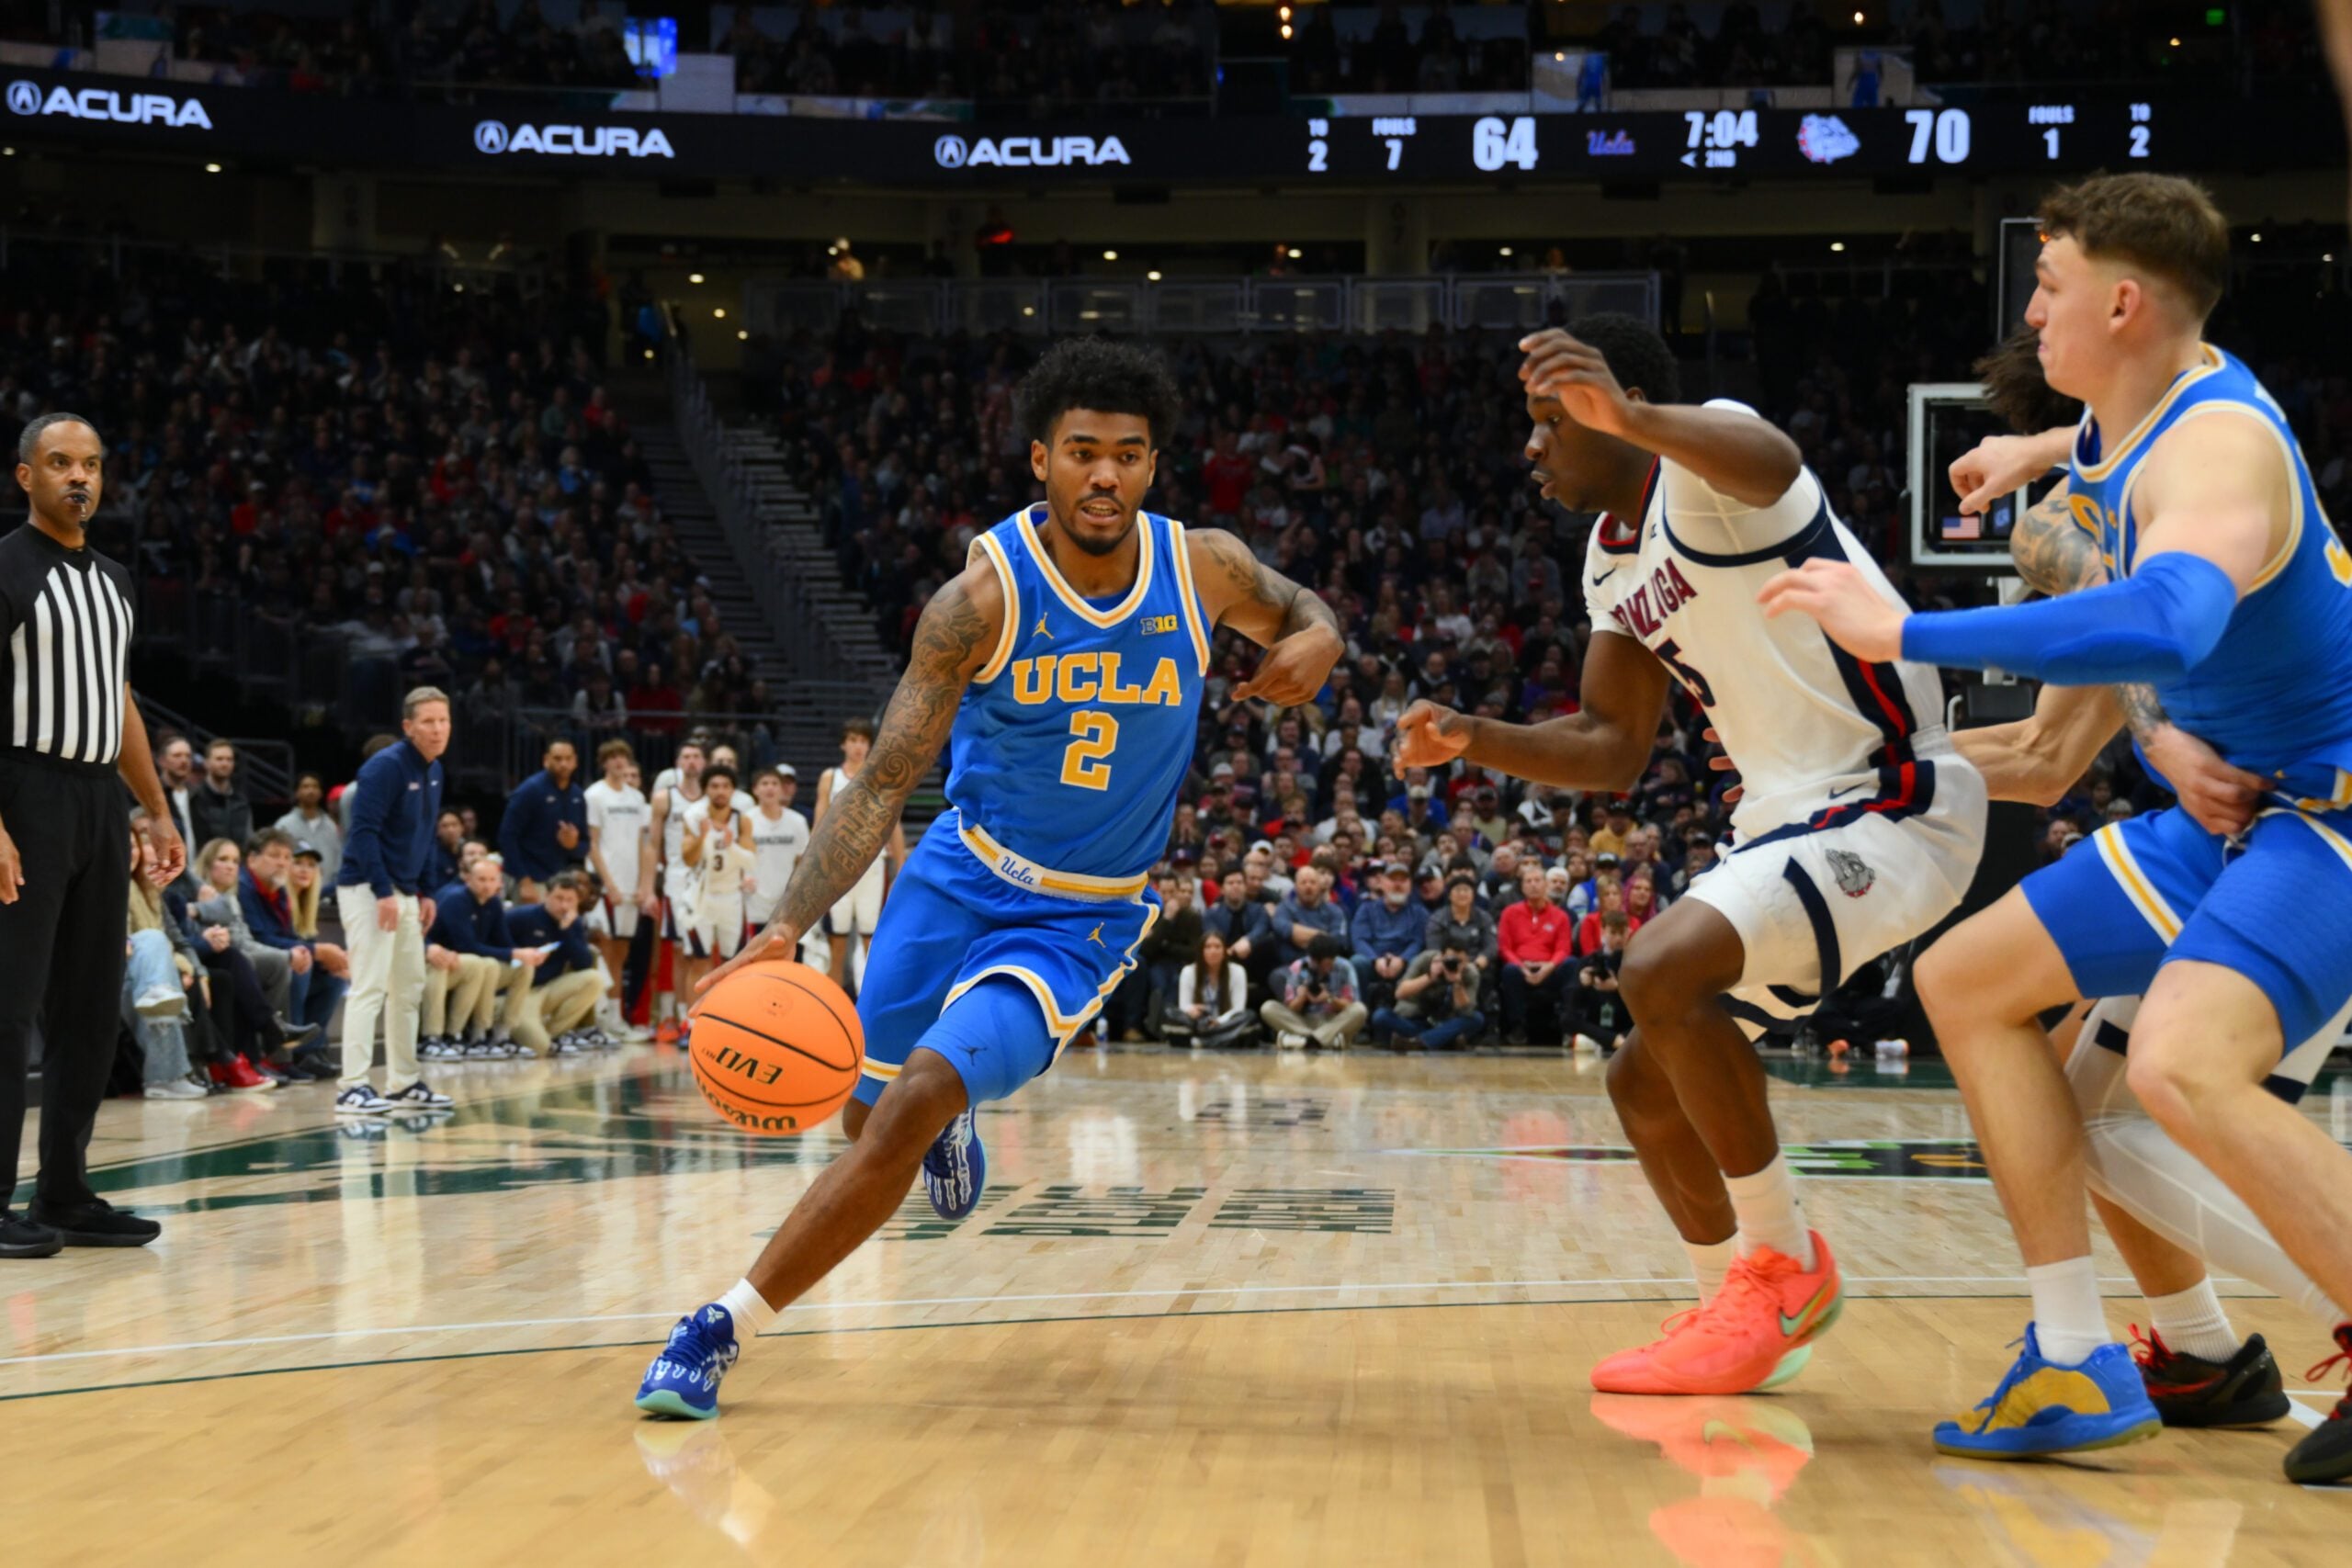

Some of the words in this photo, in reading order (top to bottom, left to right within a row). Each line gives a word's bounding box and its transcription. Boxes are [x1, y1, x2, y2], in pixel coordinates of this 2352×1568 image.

[42, 87, 212, 130] ACURA
[2029, 105, 2075, 124] FOULS
[509, 124, 675, 158] ACURA
[1372, 118, 1416, 136] FOULS
[1473, 117, 1539, 171] 64
[1684, 110, 1759, 148] 7:04
[1905, 108, 1971, 164] 70
[2042, 128, 2059, 160] 1
[2129, 125, 2150, 157] 2
[967, 135, 1131, 166] ACURA
[1308, 140, 1328, 171] 2
[1385, 139, 1402, 170] 7
[1012, 651, 1182, 706] UCLA
[1060, 709, 1119, 791] 2
[713, 854, 723, 872] 3
[1001, 856, 1034, 885] Ucla
[716, 1046, 783, 1085] EVO
[979, 1185, 1209, 1237] PLEDGE
[1208, 1189, 1396, 1234] ARENA
